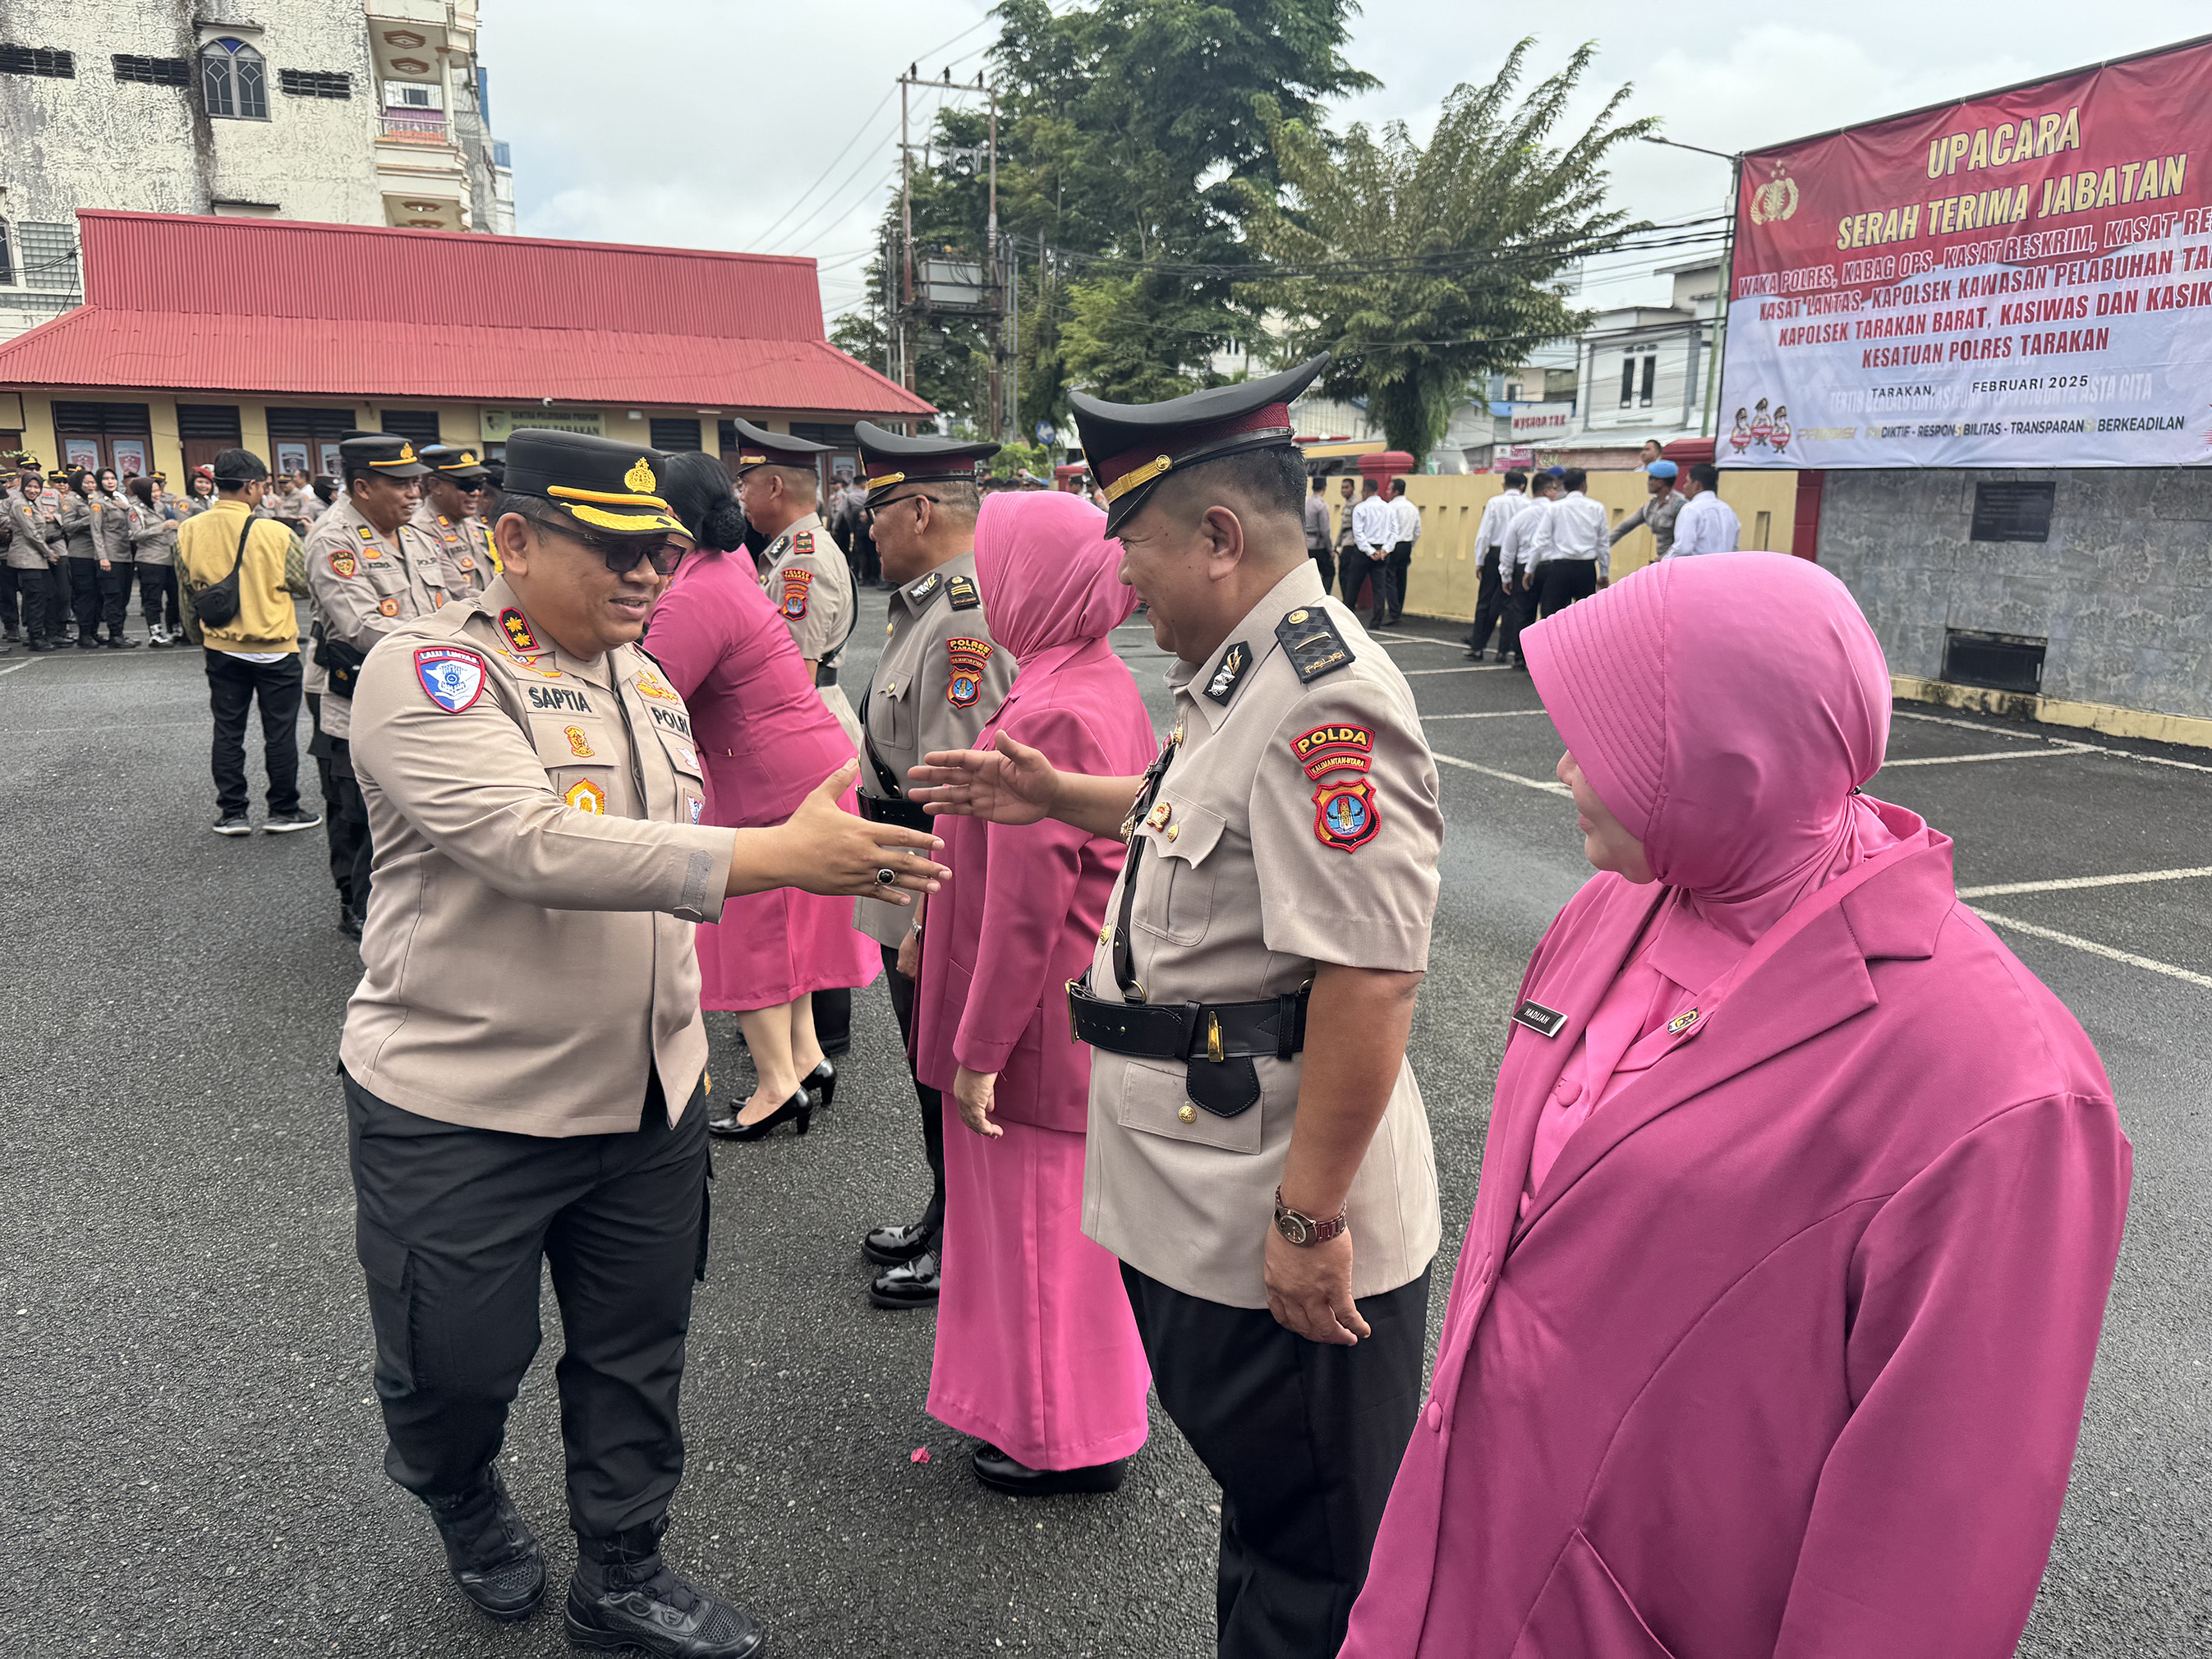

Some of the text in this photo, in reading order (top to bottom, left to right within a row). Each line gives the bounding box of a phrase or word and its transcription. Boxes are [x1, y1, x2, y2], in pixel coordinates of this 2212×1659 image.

[1925, 105, 2081, 180] UPACARA
[1836, 153, 2187, 251] SERAH TERIMA JABATAN
[1739, 273, 1777, 297] WAKA
[1781, 264, 1837, 293] POLRES,
[1842, 255, 1895, 285] KABAG
[1898, 250, 1937, 278] OPS,
[1943, 239, 2003, 270] KASAT
[2003, 225, 2098, 263] RESKRIM,
[2104, 212, 2178, 248] KASAT
[1759, 297, 1802, 321] KASAT
[1805, 289, 1865, 316] LANTAS,
[1871, 278, 1952, 310] KAPOLSEK
[1957, 266, 2048, 301] KAWASAN
[2053, 250, 2174, 287] PELABUHAN
[1778, 322, 1850, 347] KAPOLSEK
[1856, 315, 1927, 340] TARAKAN
[1932, 306, 1992, 333] BARAT,
[1999, 295, 2089, 326] KASIWAS
[2095, 289, 2139, 316] DAN
[1862, 342, 1943, 369] KESATUAN
[1948, 335, 2013, 361] POLRES
[2021, 327, 2109, 356] TARAKAN
[1871, 375, 2089, 399] TARAKAN, FEBRUARI 2025
[2097, 416, 2185, 432] BERKEADILAN
[420, 650, 478, 664] LALU LINTAS
[950, 639, 991, 654] POLRES
[954, 646, 986, 656] TARAKAN
[528, 686, 592, 713] SAPTIA
[651, 706, 691, 738] POLRI
[1296, 728, 1367, 754] POLDA
[1524, 1008, 1551, 1025] HADIJAH
